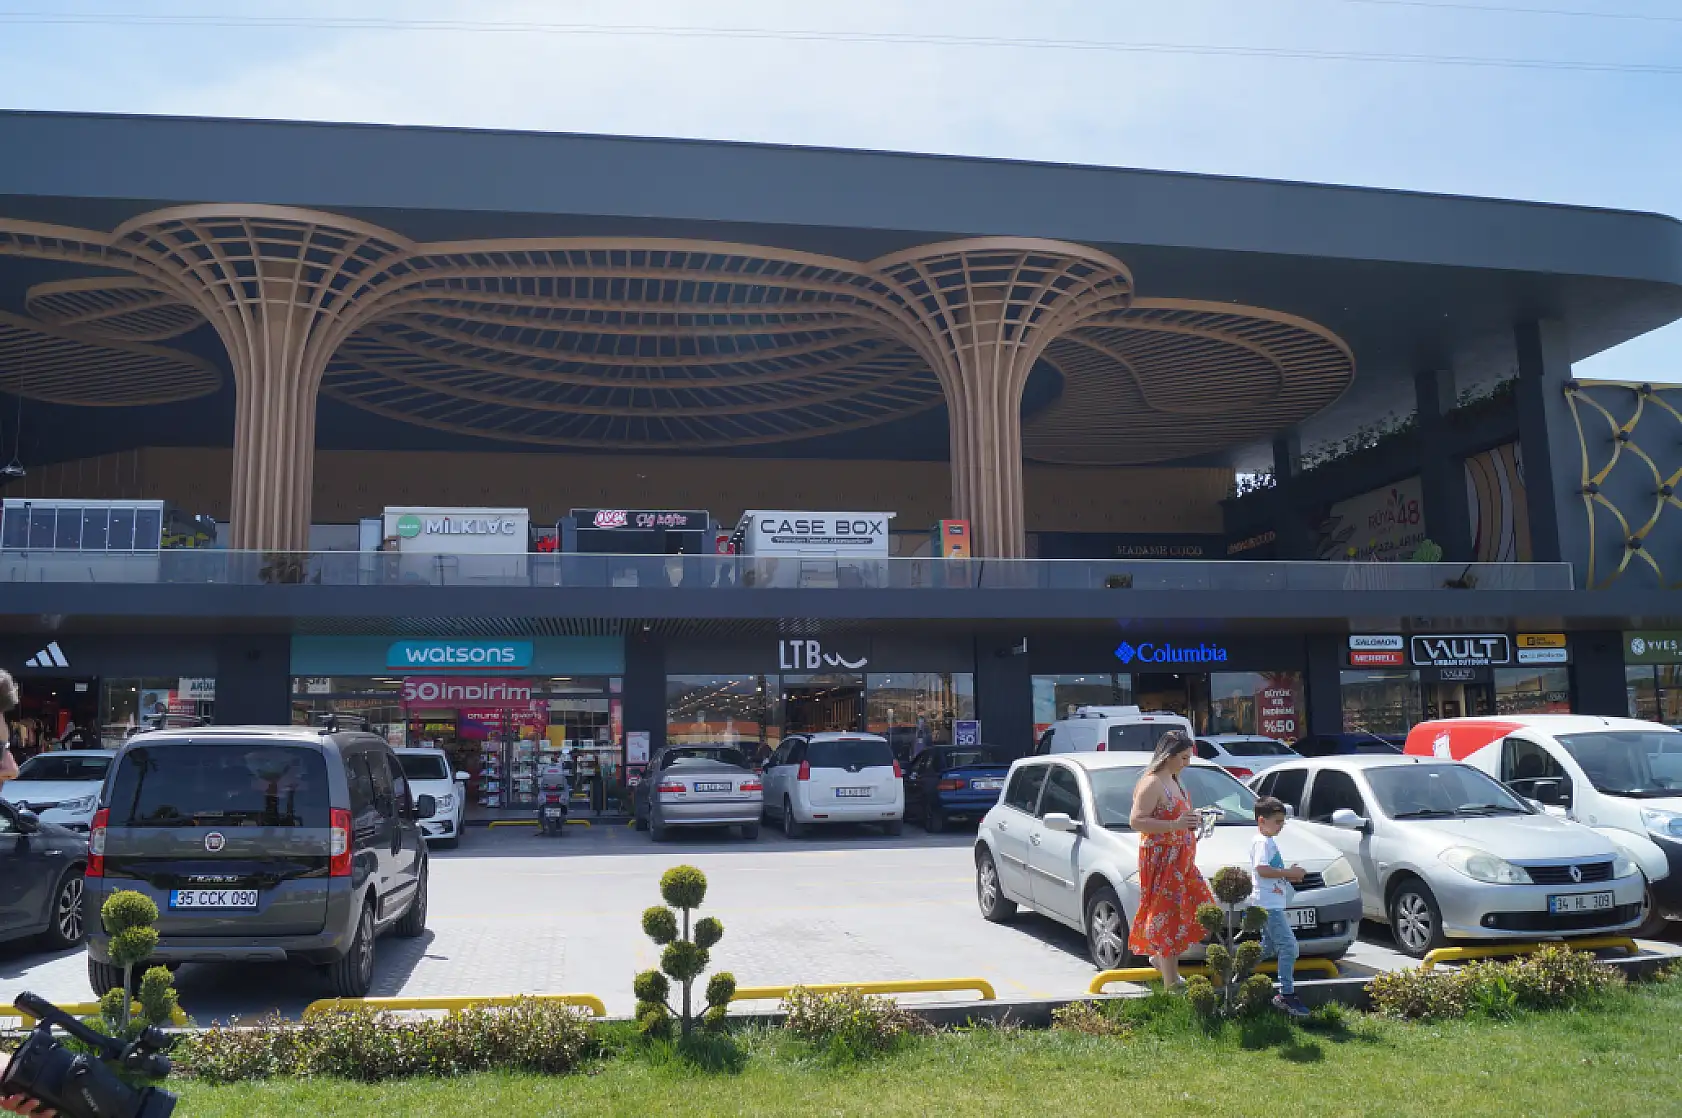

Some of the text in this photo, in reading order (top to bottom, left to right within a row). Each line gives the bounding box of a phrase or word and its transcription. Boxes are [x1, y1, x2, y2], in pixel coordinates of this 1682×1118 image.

[760, 519, 883, 535] CASE BOX
[1354, 638, 1398, 646] SALOMON
[1422, 639, 1498, 659] VAULT
[1647, 640, 1678, 650] YVES
[405, 645, 516, 663] watsons
[778, 640, 821, 669] LTB
[1137, 643, 1227, 663] Columbia
[1354, 654, 1398, 663] MERRELL
[1264, 719, 1295, 733] %50
[178, 891, 257, 905] 35 CCK 090
[1296, 910, 1315, 924] 119
